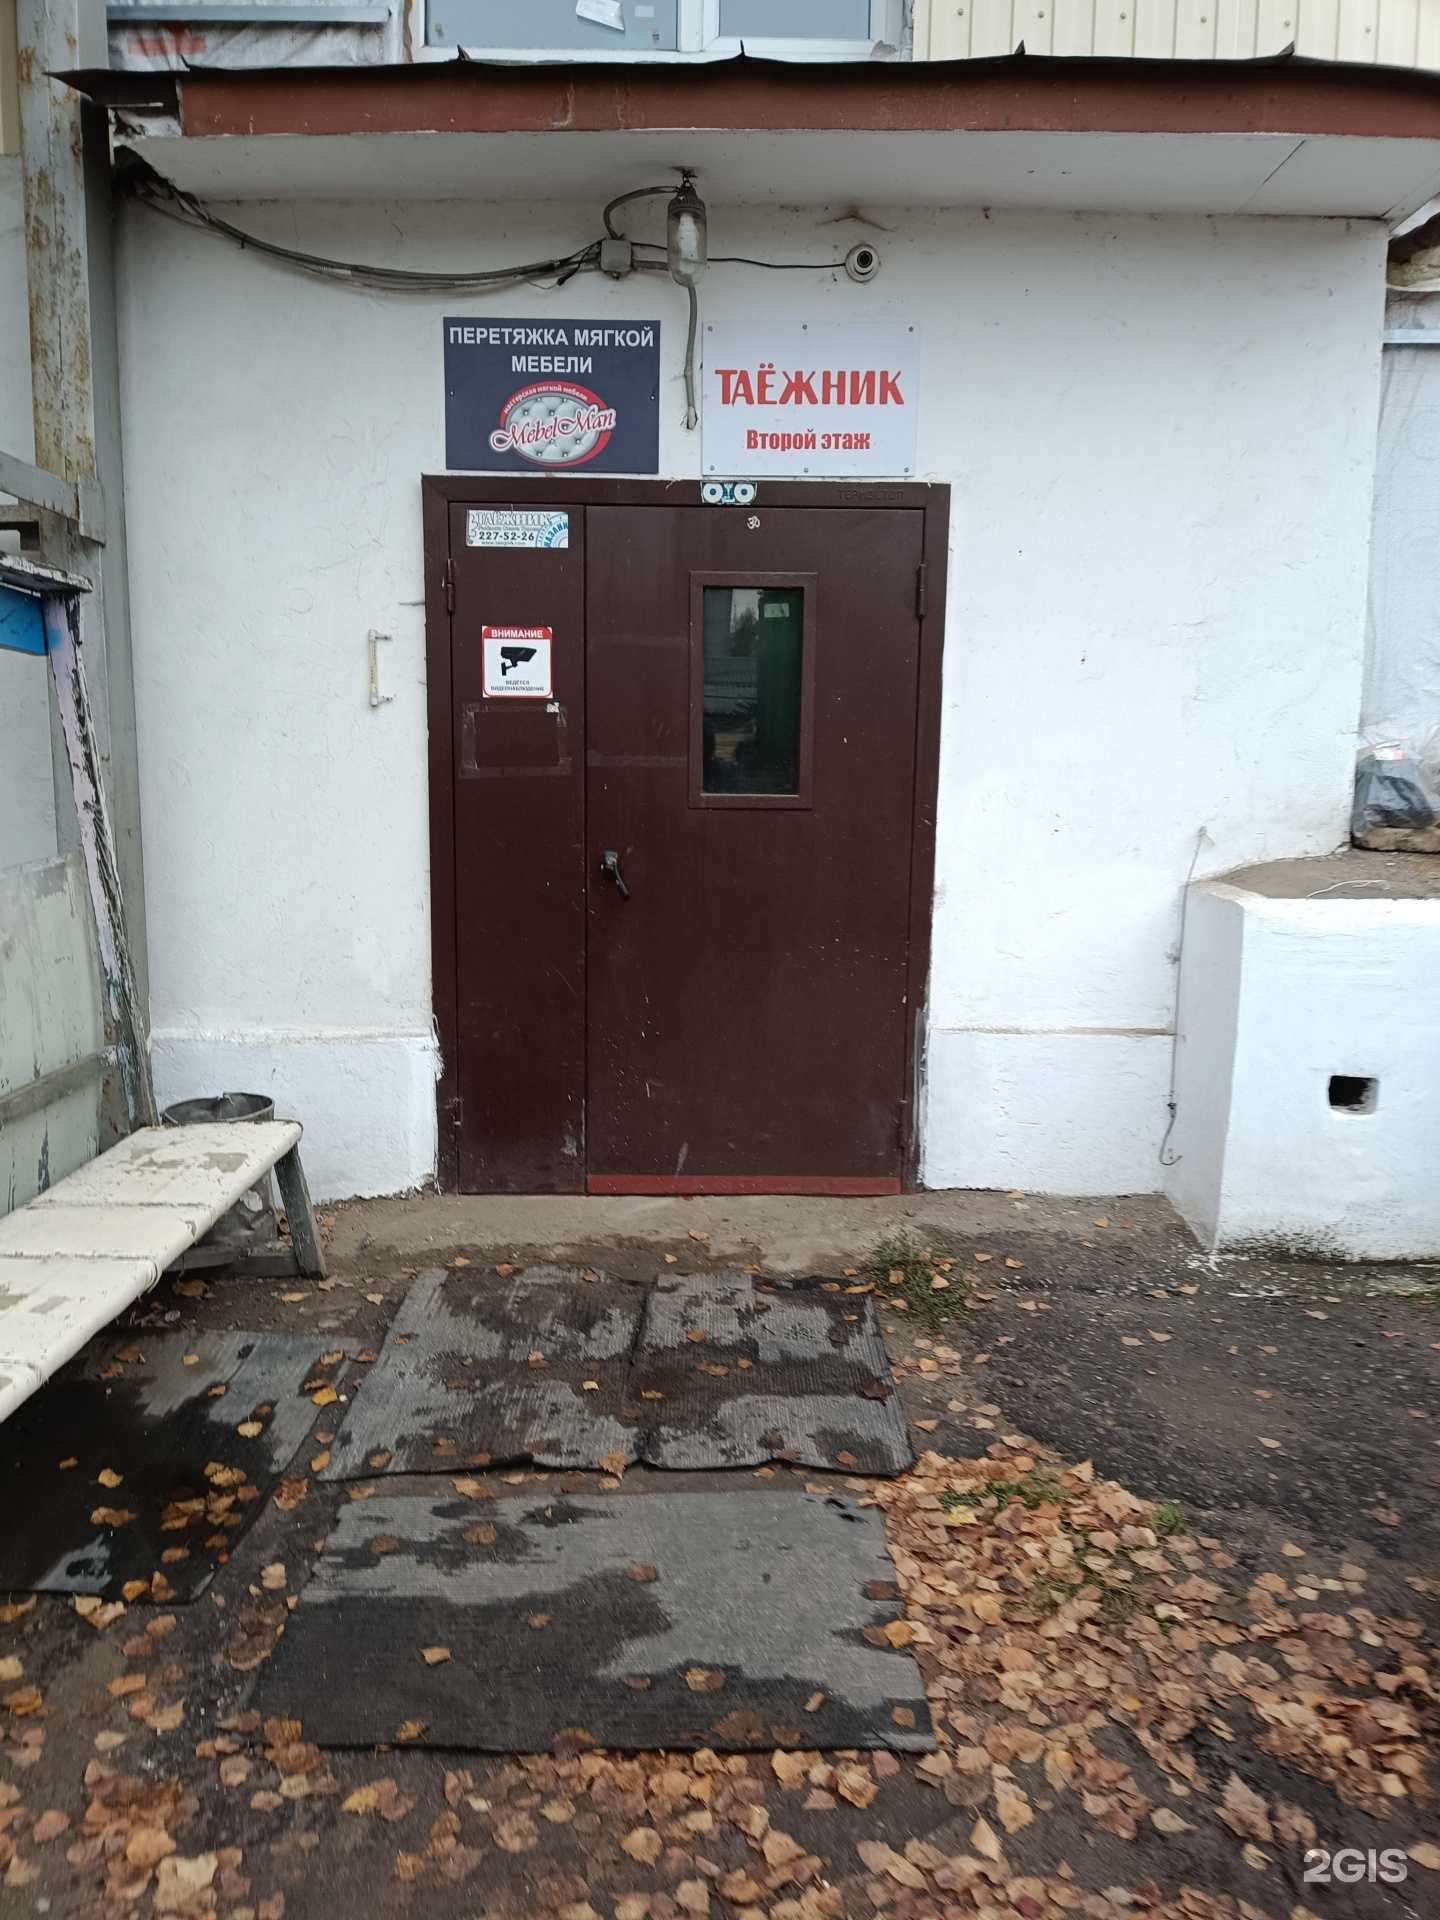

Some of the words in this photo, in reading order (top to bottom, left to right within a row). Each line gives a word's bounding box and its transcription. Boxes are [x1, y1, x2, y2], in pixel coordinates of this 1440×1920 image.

[449, 326, 569, 346] ПЕРЕТЯЖКА
[574, 326, 654, 347] МЯГКОЙ
[511, 355, 593, 373] МЕБЕЛИ
[714, 362, 905, 406] ТАЁЖНИК
[746, 427, 816, 452] Второй
[820, 431, 871, 450] этаж
[479, 531, 535, 541] 227-52-26
[490, 629, 544, 638] ВНИМАНИЕ
